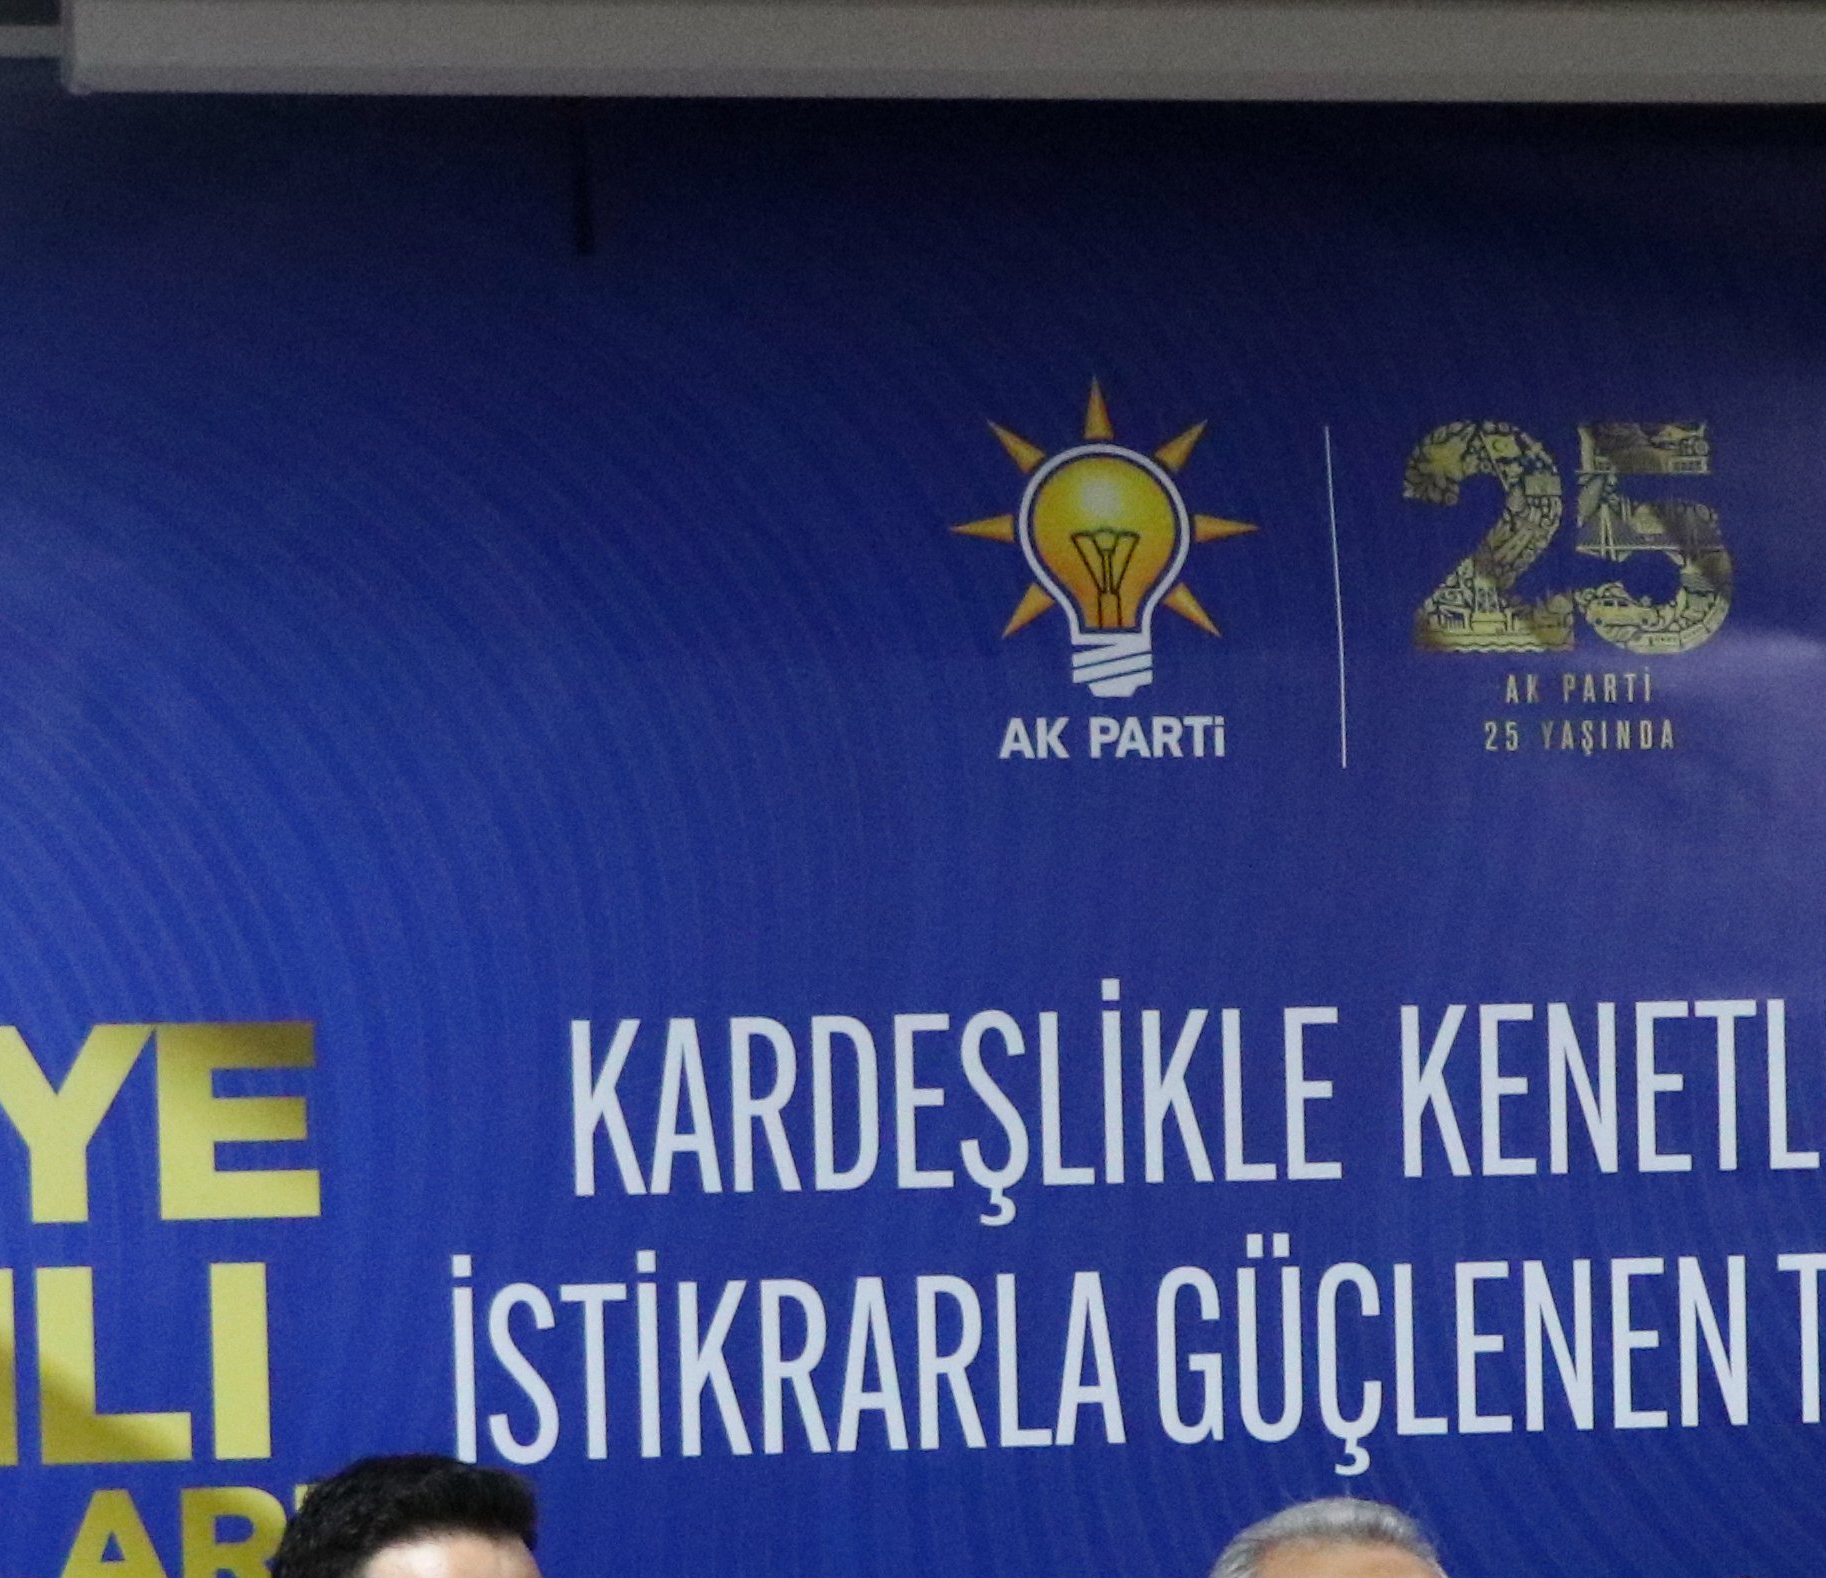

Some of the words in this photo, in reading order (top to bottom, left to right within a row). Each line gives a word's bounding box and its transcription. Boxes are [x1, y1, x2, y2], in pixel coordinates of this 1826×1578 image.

[1403, 419, 1733, 654] 25
[999, 716, 1070, 760] AK
[1484, 720, 1520, 752] 25
[1541, 718, 1675, 756] YAŞINDA
[1504, 673, 1539, 704] AK
[1563, 666, 1653, 702] PARTİ
[570, 978, 1343, 1225] KARDEŞLİKLE
[450, 1249, 1126, 1465] İSTİKRARLA
[1156, 1232, 1749, 1476] GÜÇLENEN
